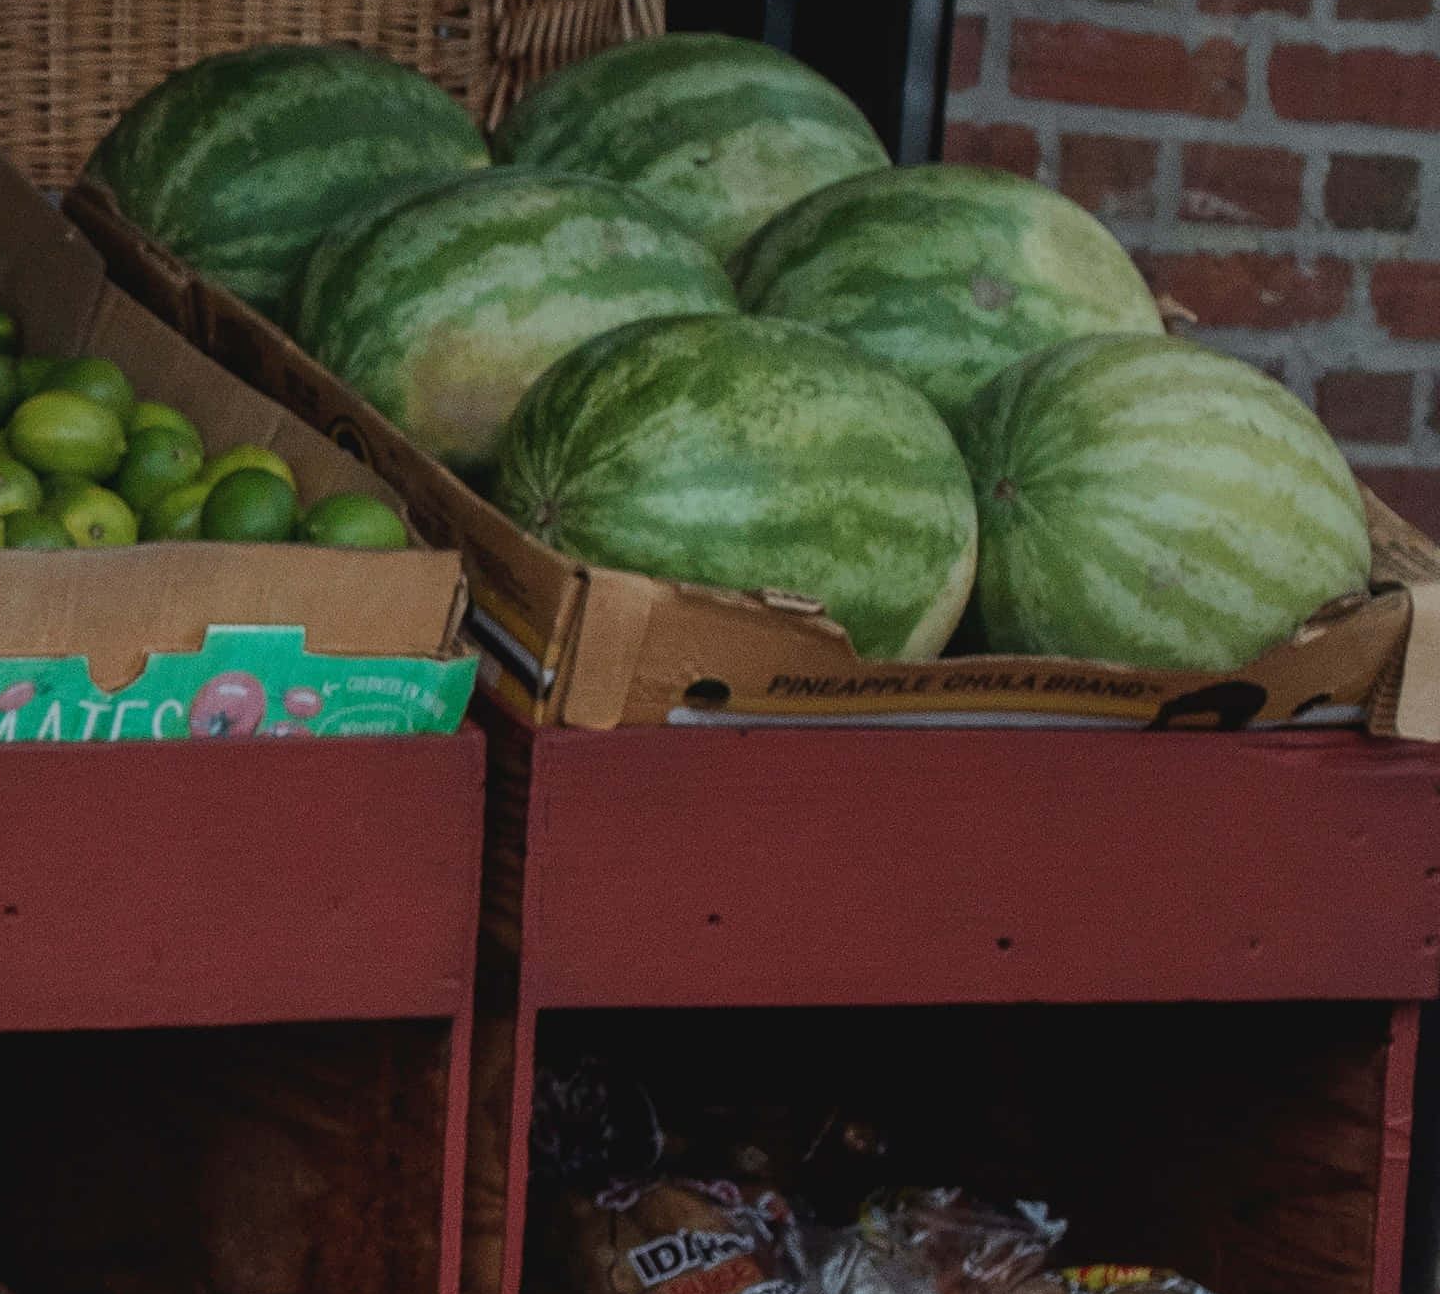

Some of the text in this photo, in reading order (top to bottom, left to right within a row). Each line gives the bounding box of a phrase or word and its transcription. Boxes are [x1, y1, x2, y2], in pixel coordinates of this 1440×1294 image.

[767, 672, 1147, 699] PINEAPPLE CHULA BRAND
